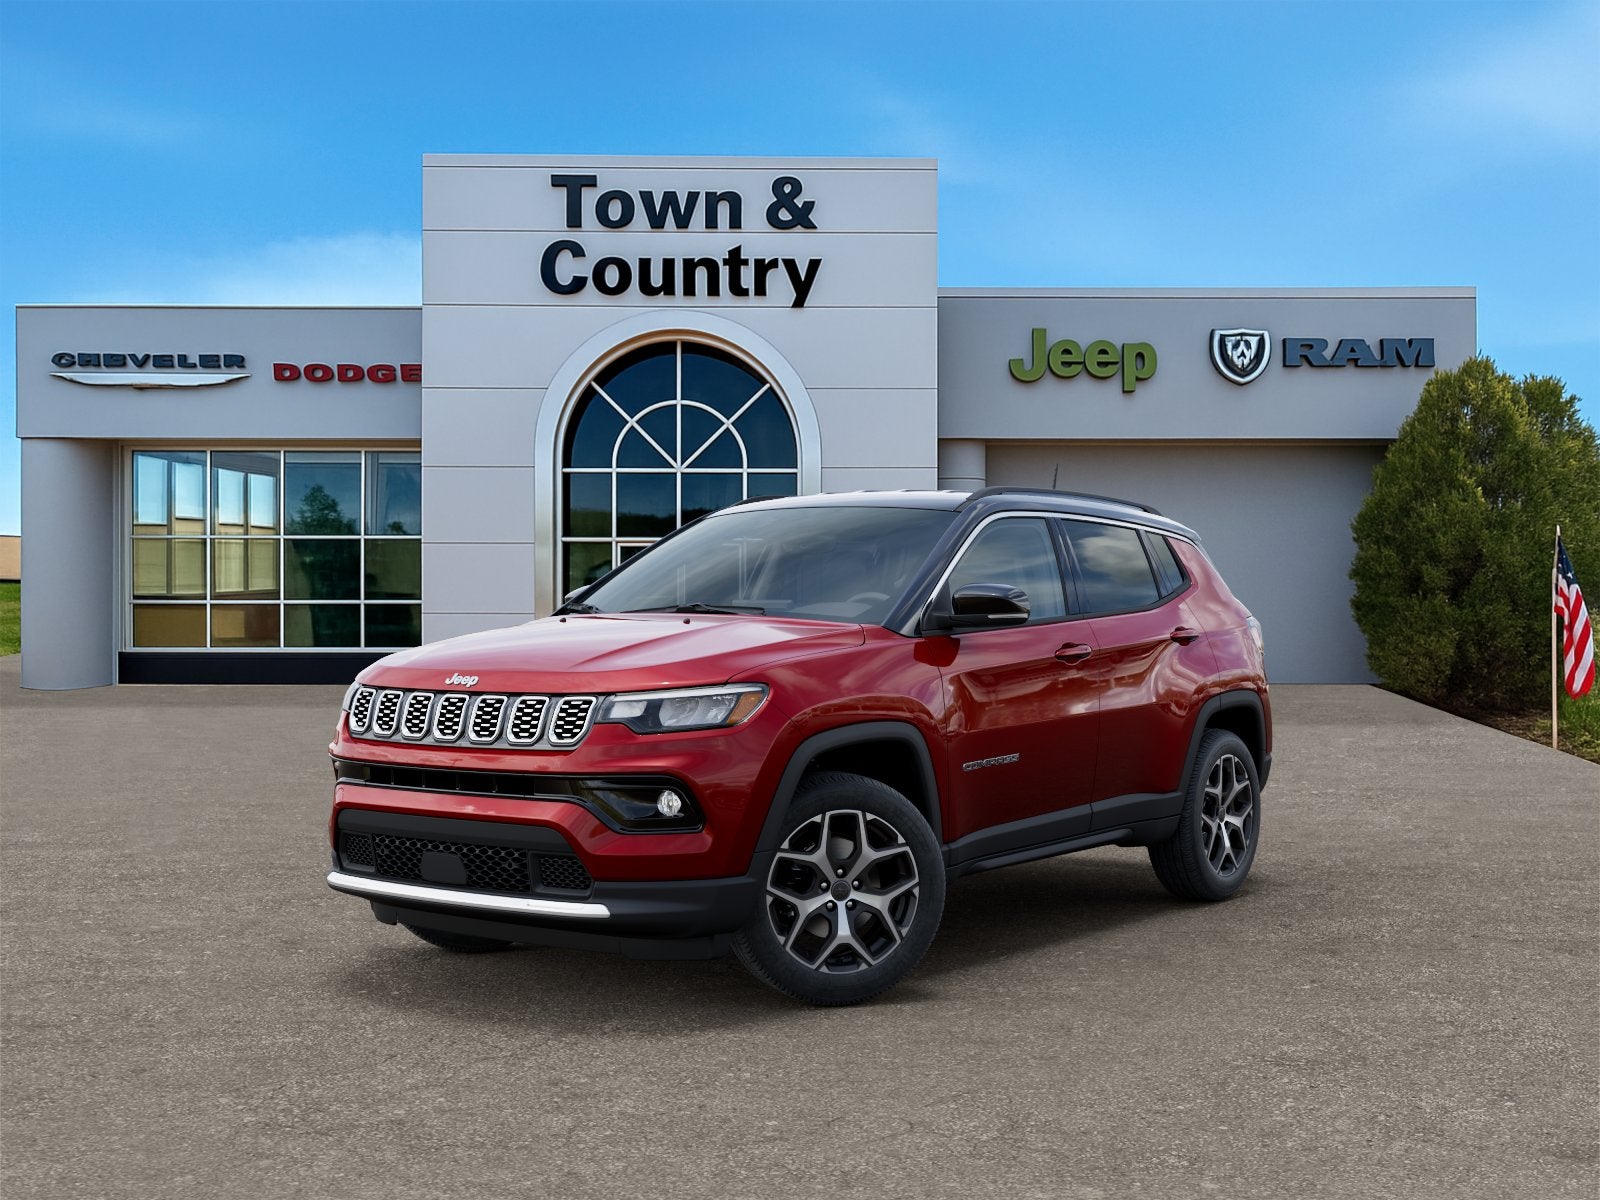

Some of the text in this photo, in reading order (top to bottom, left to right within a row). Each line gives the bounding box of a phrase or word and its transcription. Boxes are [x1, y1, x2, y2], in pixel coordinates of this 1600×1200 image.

[550, 174, 818, 230] Town &
[539, 239, 823, 308] Country
[272, 362, 422, 384] DODGE
[1008, 327, 1158, 393] Jeep
[1282, 337, 1436, 368] RAM
[444, 672, 480, 688] Jeep
